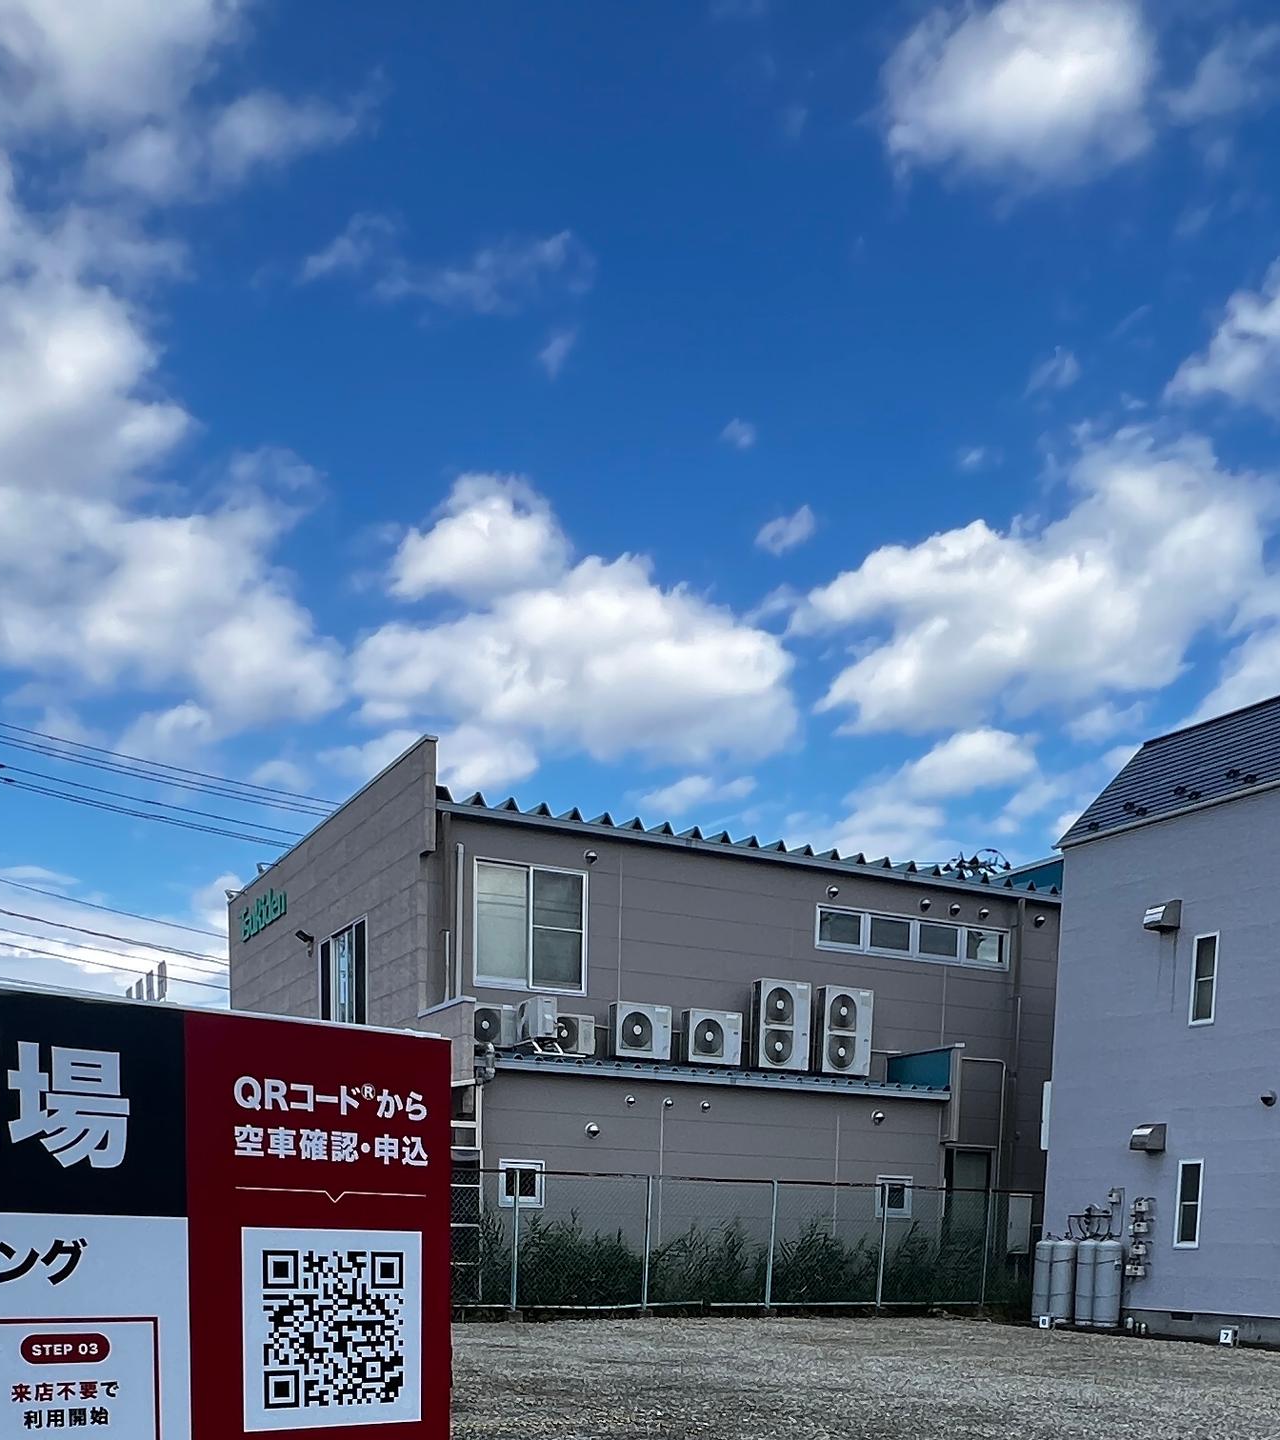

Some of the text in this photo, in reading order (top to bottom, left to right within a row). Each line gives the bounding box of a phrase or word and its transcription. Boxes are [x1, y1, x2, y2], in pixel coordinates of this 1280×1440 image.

[234, 1124, 428, 1166] 空車確認・申込
[1223, 1332, 1230, 1341] 7
[31, 1343, 100, 1357] STEP 03
[11, 1380, 118, 1403] 来店不要で
[23, 1407, 109, 1430] 利用開始
